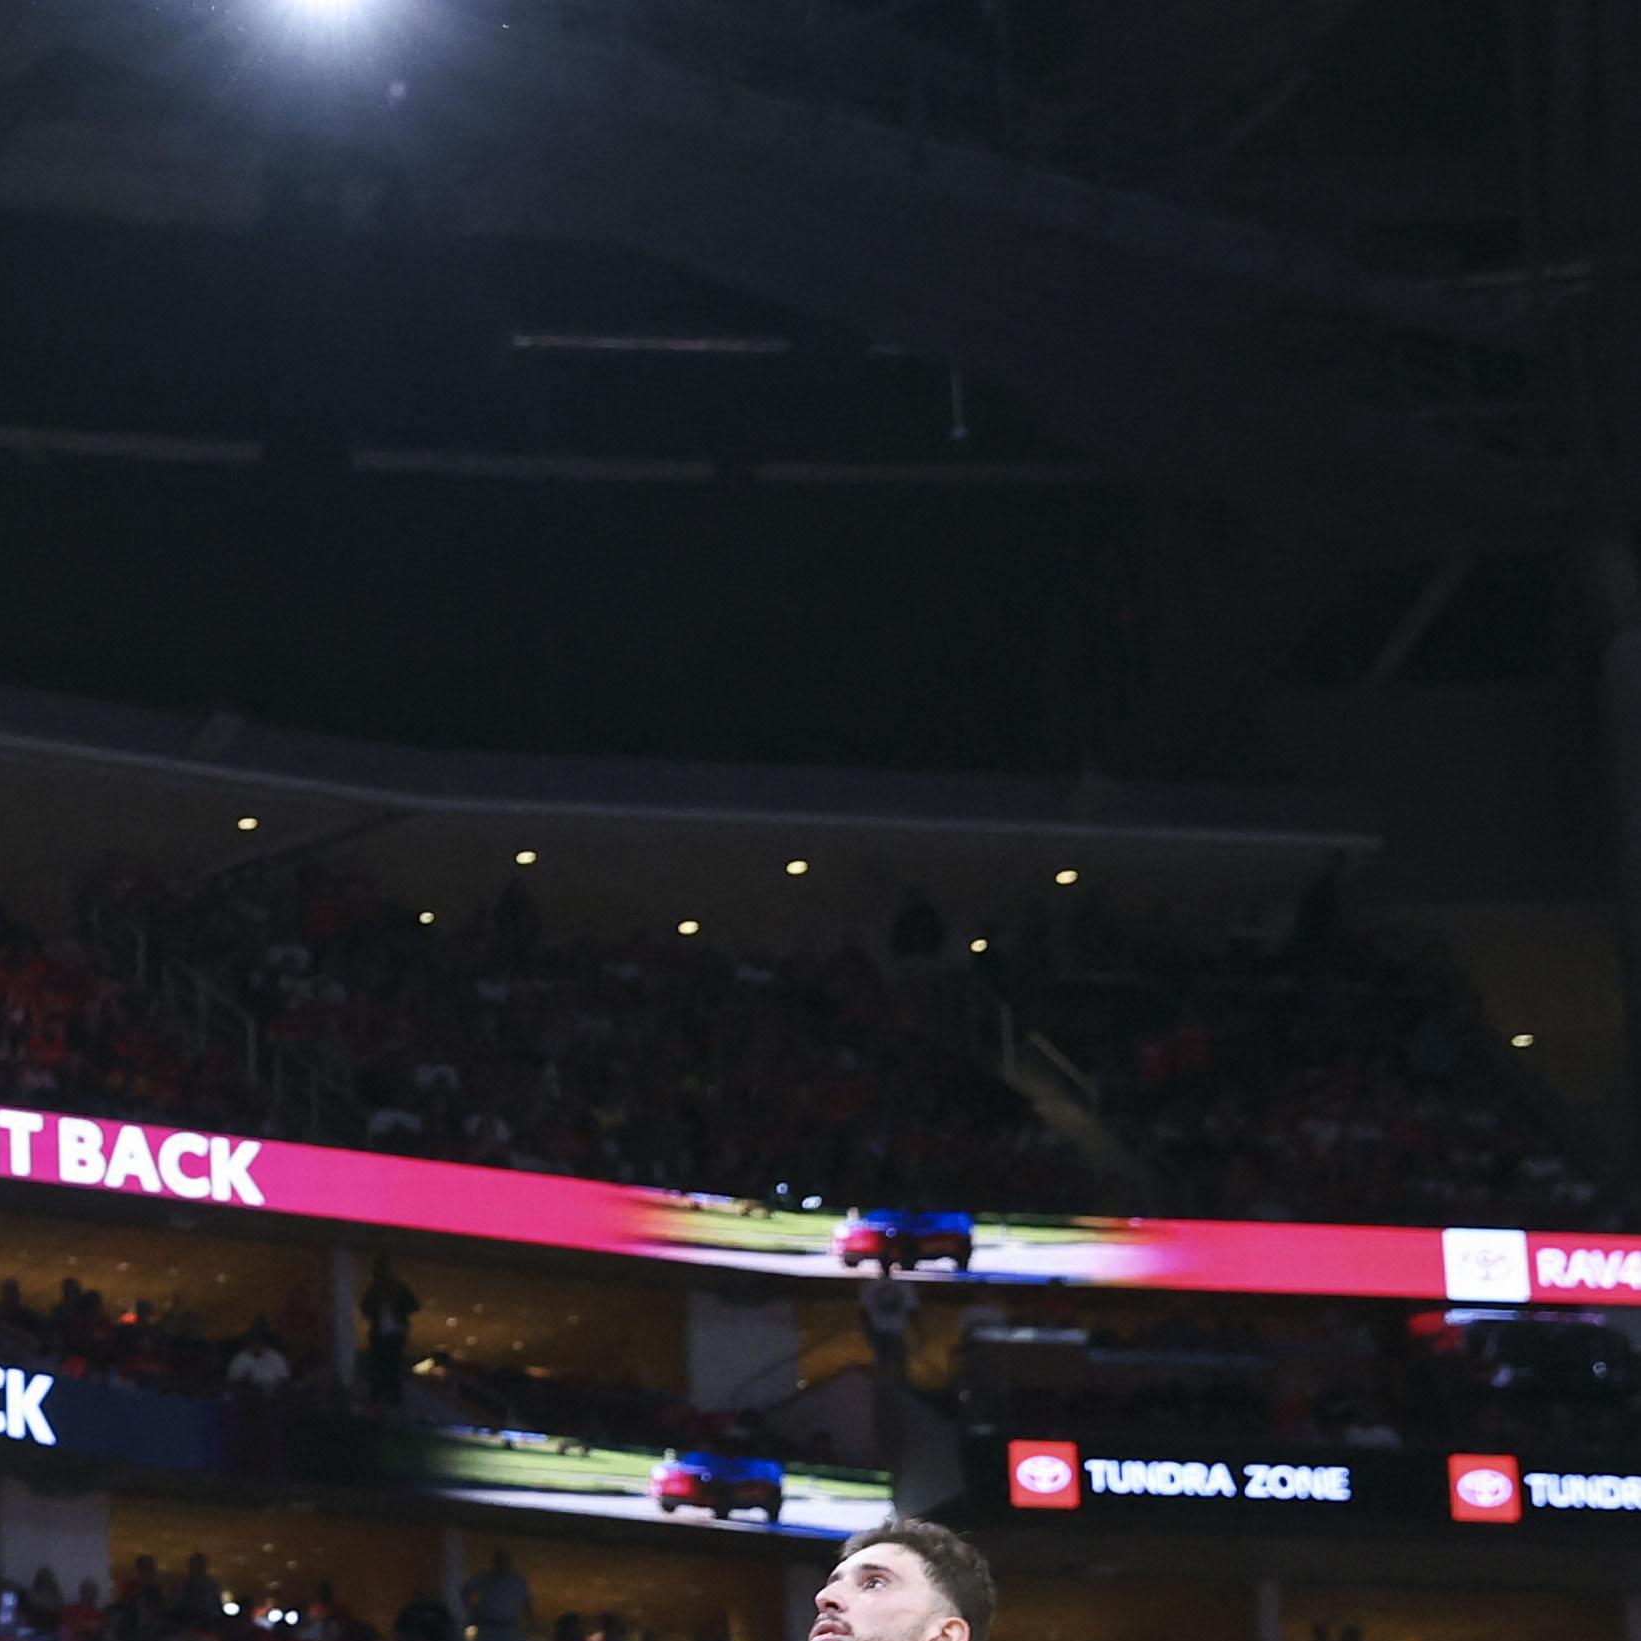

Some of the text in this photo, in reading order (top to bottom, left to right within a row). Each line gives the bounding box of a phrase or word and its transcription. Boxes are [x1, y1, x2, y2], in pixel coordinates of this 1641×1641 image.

[56, 1115, 265, 1207] BACK
[1084, 1458, 1352, 1501] TUNDRA ZONE
[1523, 1472, 1641, 1511] TUNDR
